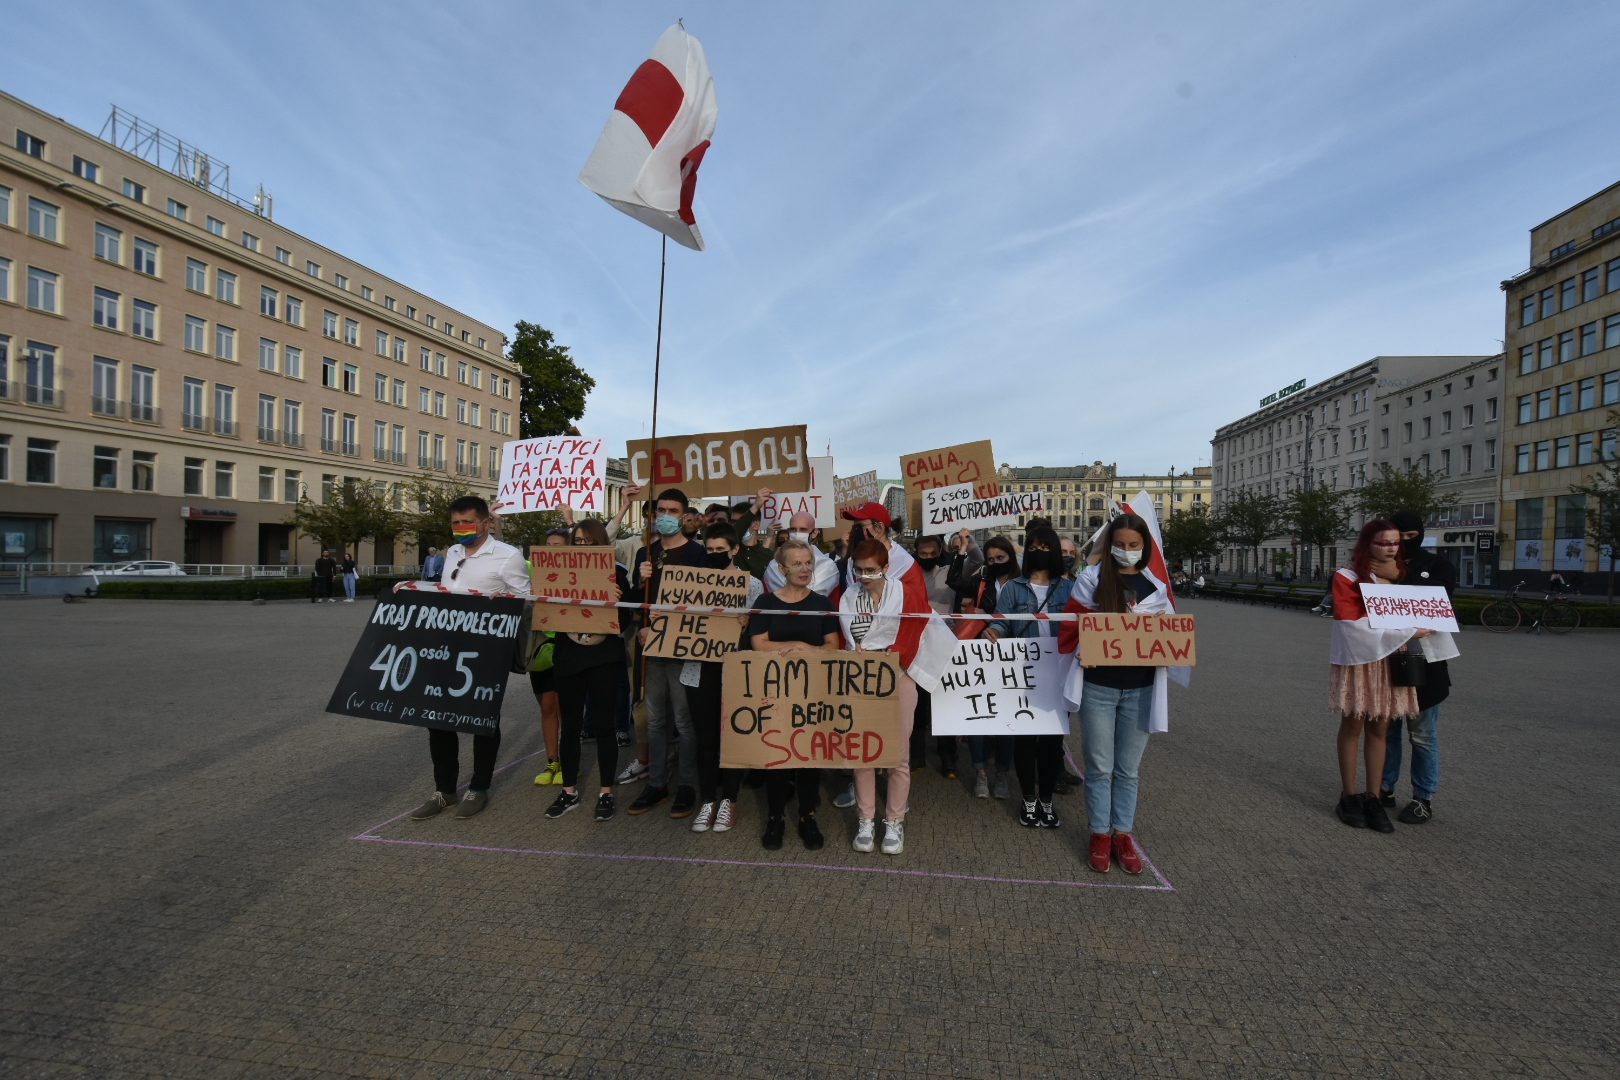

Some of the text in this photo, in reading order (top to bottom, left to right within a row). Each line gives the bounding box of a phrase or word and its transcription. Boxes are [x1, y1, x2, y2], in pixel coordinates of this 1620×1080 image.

[511, 457, 595, 479] ГА-ГА-ГА
[630, 436, 803, 487] СВАБОДУ
[499, 477, 603, 497] ЛУКАШЭНКА
[926, 492, 936, 505] 5
[522, 489, 595, 510] ГААГА
[930, 493, 1043, 525] ZAMORDOWANYCH
[664, 570, 746, 589] ПОЛЬСКАЯ
[371, 602, 522, 639] KRAJ PROSPOŁECZNY
[1082, 616, 1195, 632] ALL WE NEED
[644, 614, 710, 653] Я НЕ
[1103, 638, 1191, 660] IS LAW
[369, 643, 451, 692] 40 osób
[424, 684, 444, 698] na
[448, 651, 480, 698] 5
[741, 659, 896, 699] I AM TIRED
[1002, 665, 1036, 688] НЕ
[370, 699, 394, 713] celi
[399, 706, 416, 720] po
[964, 692, 998, 716] ТЕ
[730, 704, 774, 735] OF
[761, 729, 883, 767] SCARED
